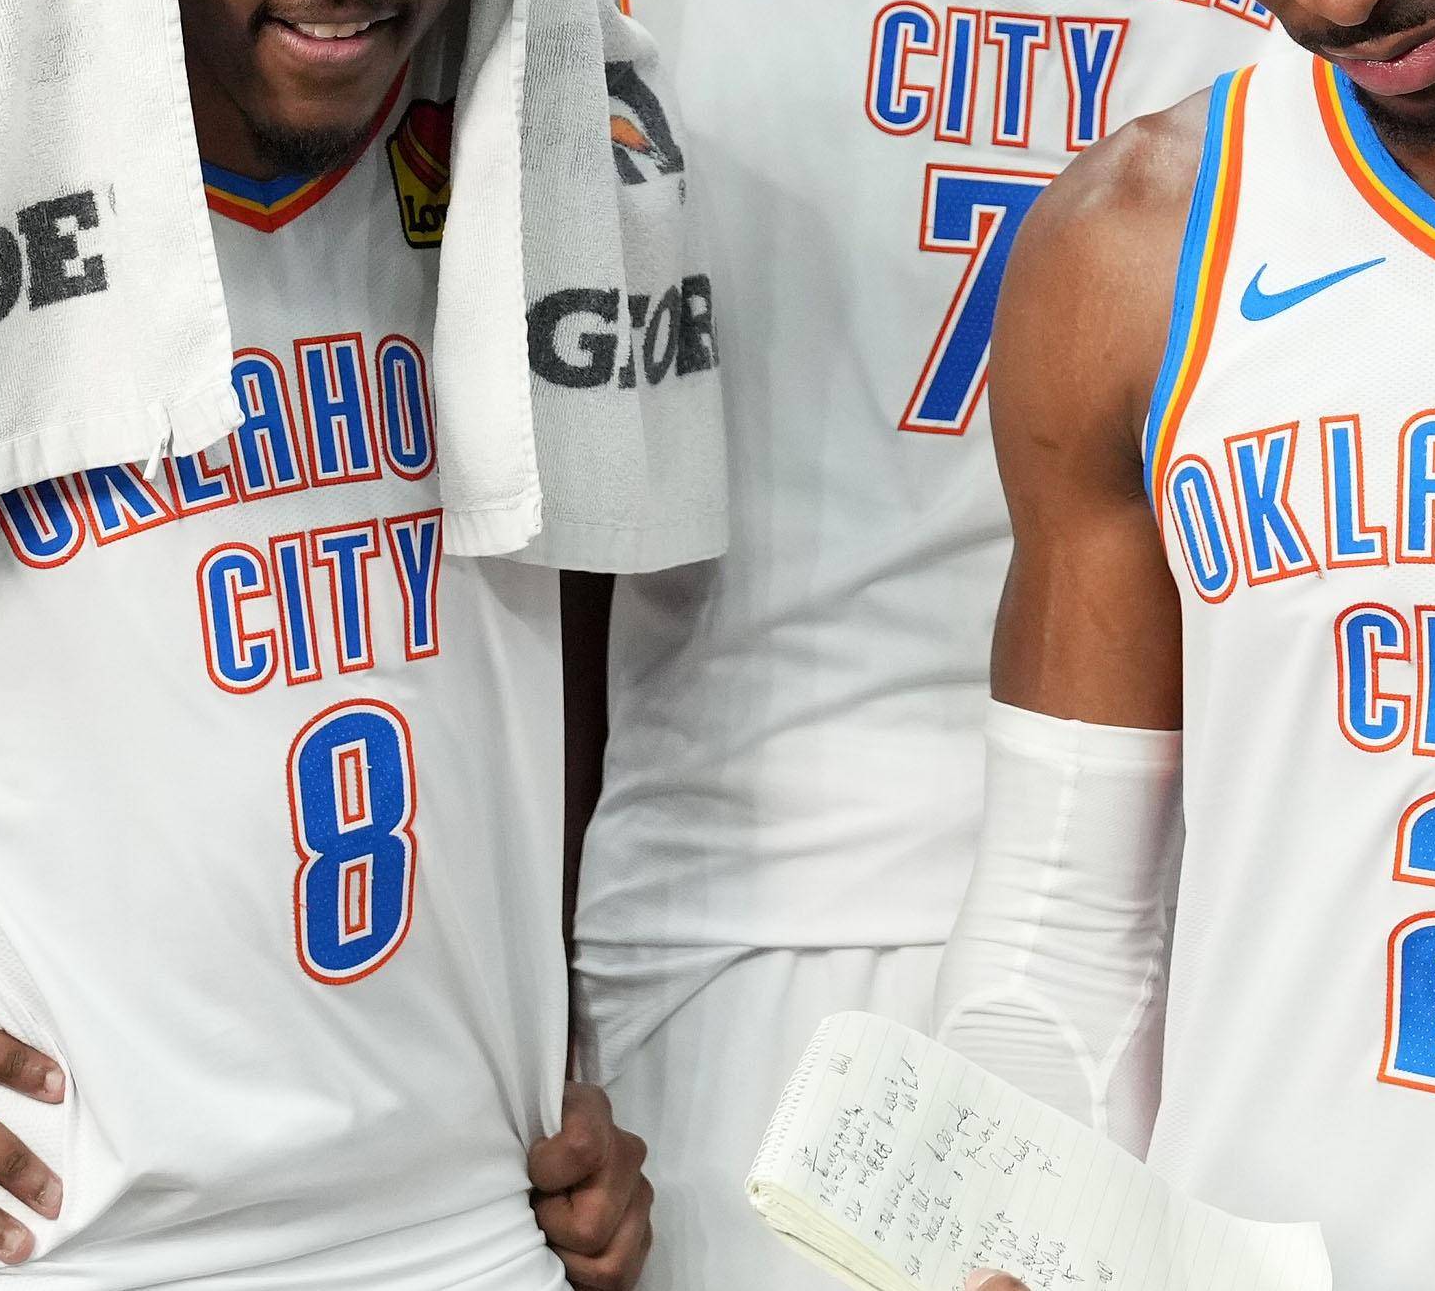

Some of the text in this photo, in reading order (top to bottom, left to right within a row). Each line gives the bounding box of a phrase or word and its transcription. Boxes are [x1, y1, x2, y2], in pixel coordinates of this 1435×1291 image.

[865, 0, 1130, 151] CITY
[898, 163, 1060, 435] 7
[196, 509, 443, 694] CITY
[285, 698, 417, 985] 8
